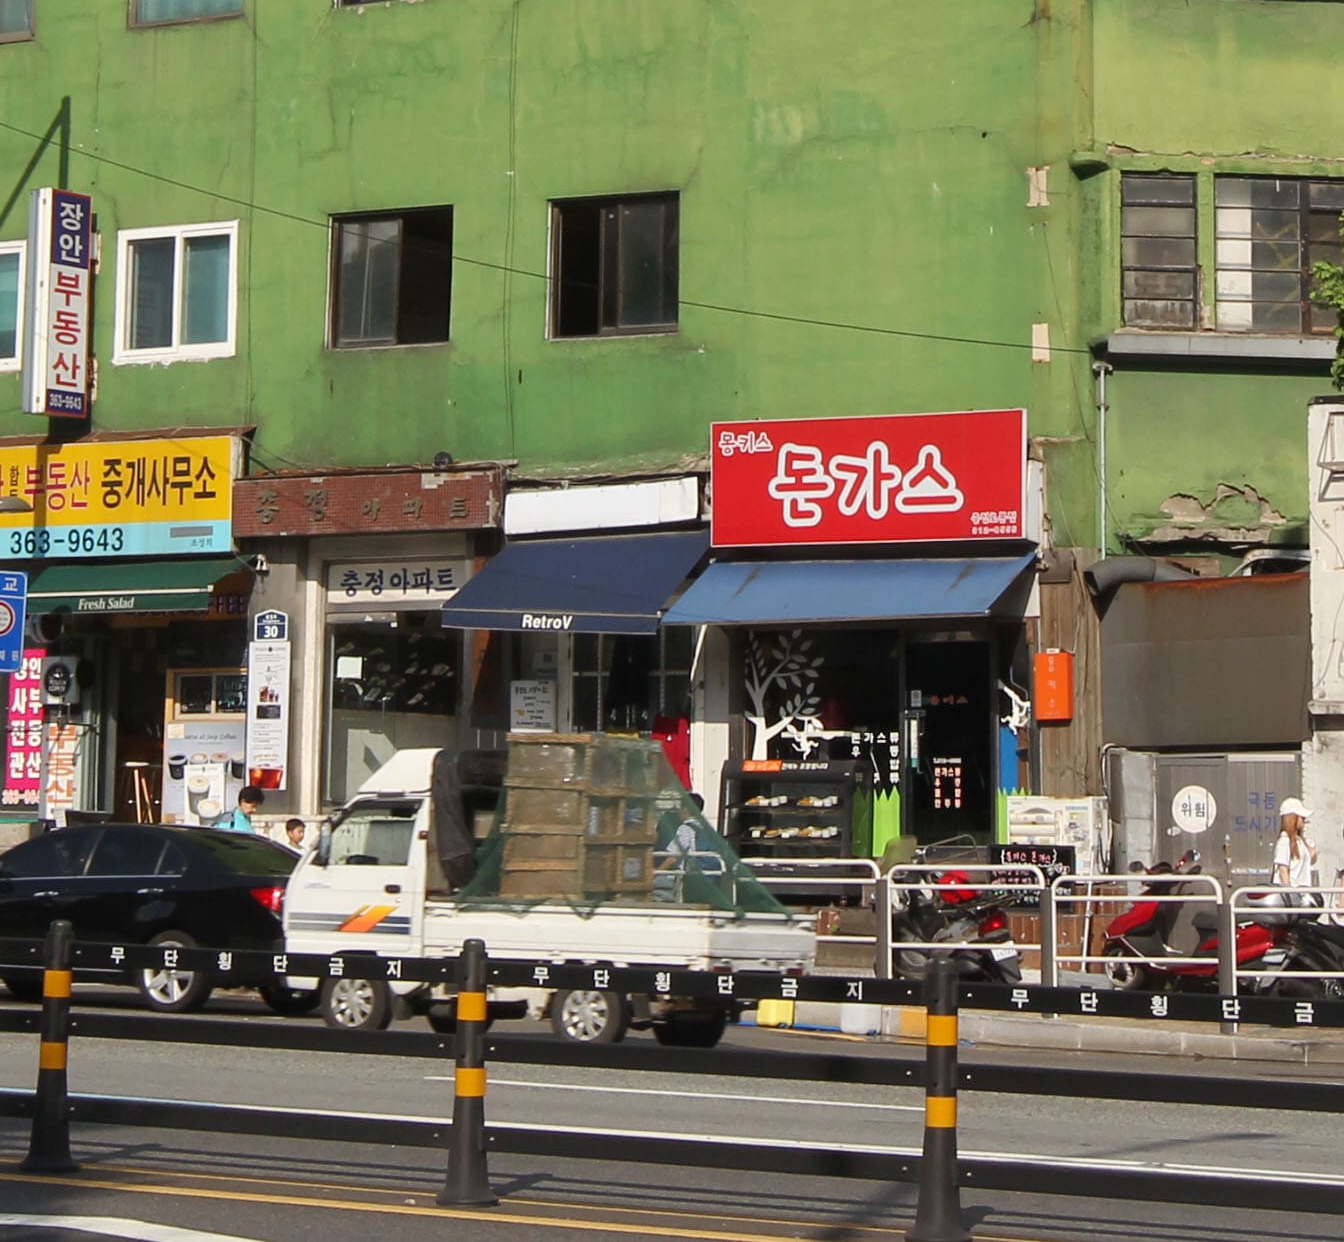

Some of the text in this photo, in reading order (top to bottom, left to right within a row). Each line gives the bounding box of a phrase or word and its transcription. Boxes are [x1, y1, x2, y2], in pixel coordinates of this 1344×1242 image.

[52, 202, 84, 388] 장안 부동산
[718, 430, 773, 457] 몽키스
[25, 459, 91, 510] 부동산
[101, 456, 217, 509] 중개사무소
[768, 440, 965, 528] 돈가스
[10, 527, 125, 555] 363-9643
[340, 566, 458, 597] 충정아파트
[78, 597, 135, 610] Fresh Salad
[263, 626, 279, 638] 30
[521, 614, 573, 630] RetroV
[9, 688, 26, 779] 사진관
[26, 688, 42, 779] 부동산
[46, 725, 80, 805] 부동산
[1181, 794, 1206, 818] 위험
